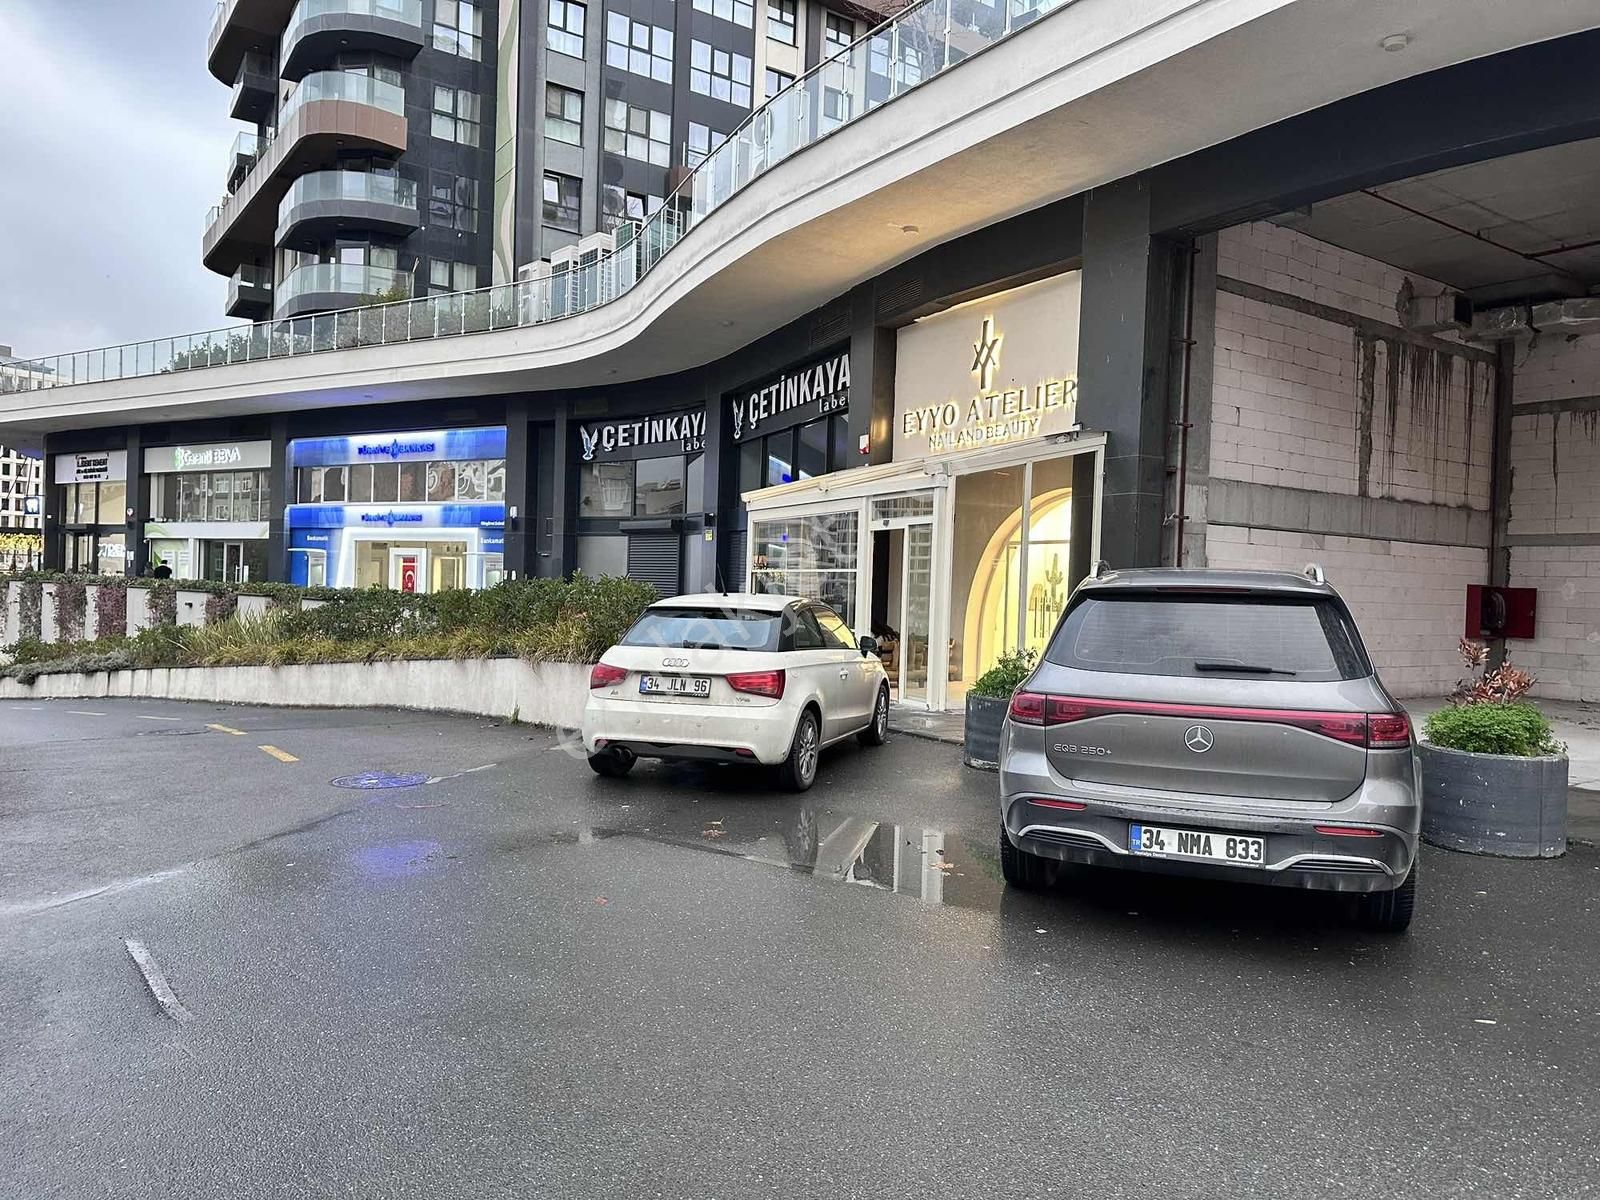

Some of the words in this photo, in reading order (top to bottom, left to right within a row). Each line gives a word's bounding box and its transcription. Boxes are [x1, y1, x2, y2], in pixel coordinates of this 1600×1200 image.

[903, 404, 957, 434] EYYO
[966, 379, 1078, 422] ATELIER
[647, 677, 660, 690] 34
[667, 678, 687, 691] JLN
[694, 679, 708, 692] 96
[1053, 743, 1078, 753] EQB
[1080, 745, 1112, 756] 250+
[1131, 838, 1141, 846] TR
[1142, 828, 1165, 851] 34
[1177, 832, 1213, 856] NMA
[1225, 837, 1262, 861] 833
